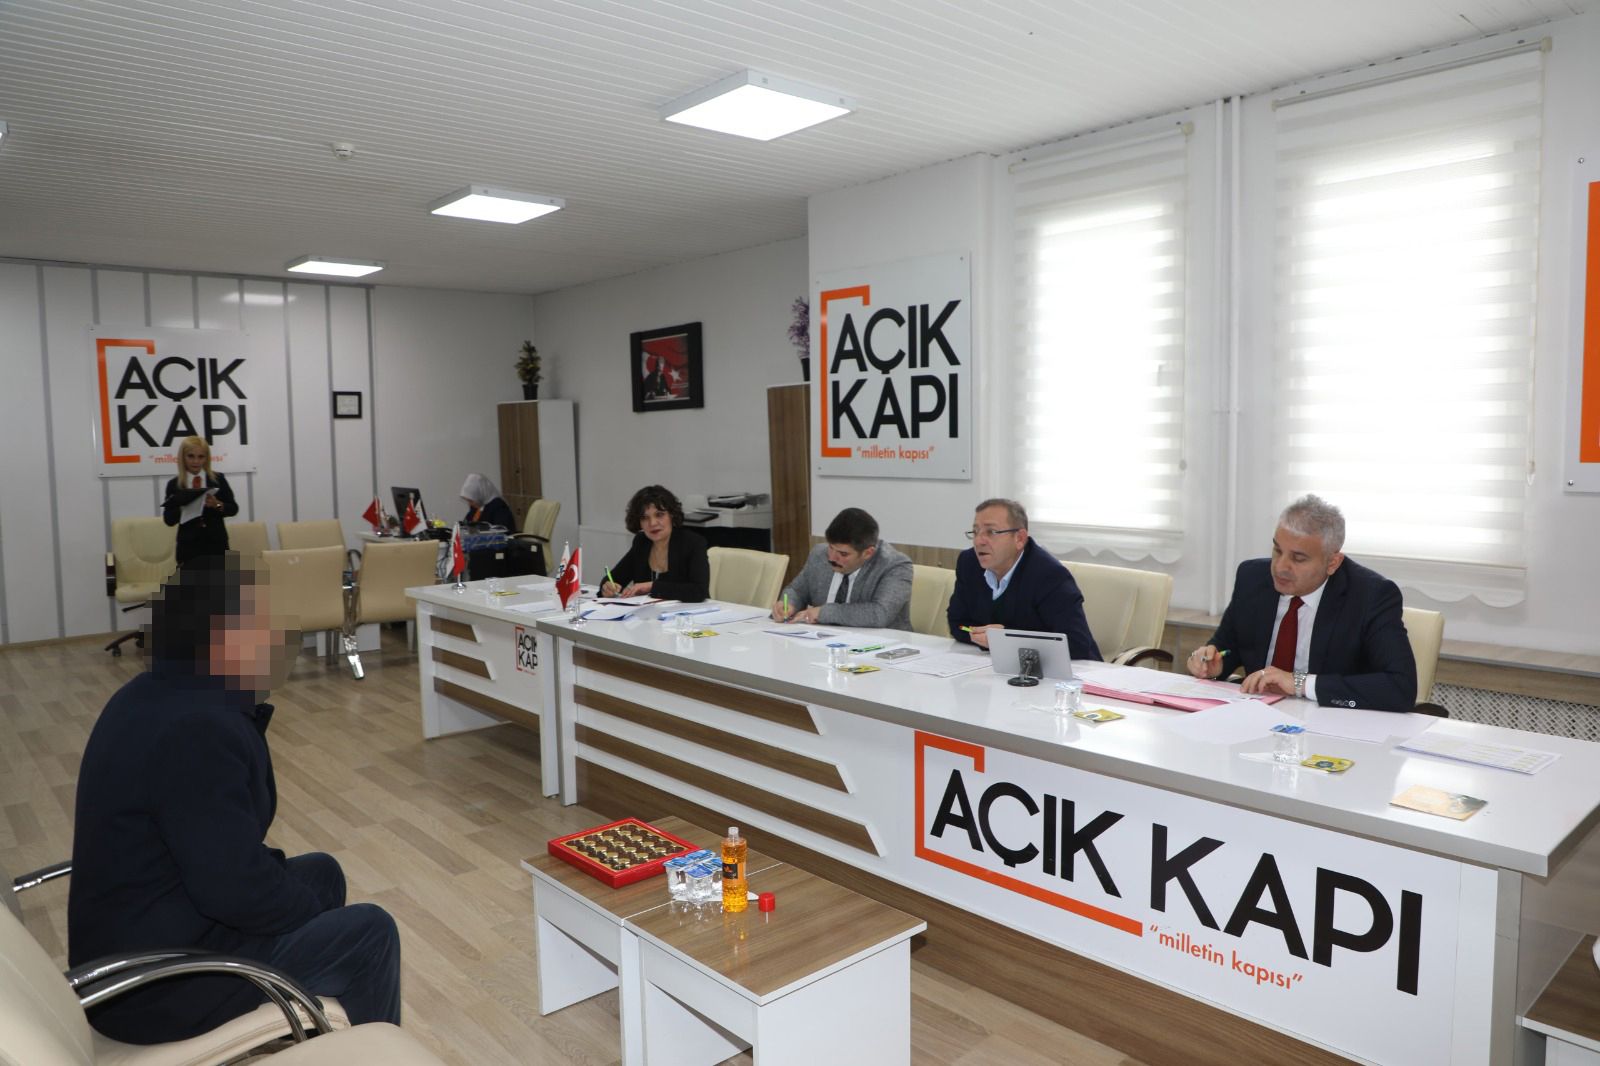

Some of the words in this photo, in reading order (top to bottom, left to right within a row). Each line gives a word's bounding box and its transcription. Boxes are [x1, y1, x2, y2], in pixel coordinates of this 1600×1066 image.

[829, 300, 961, 374] AÇIK
[115, 356, 247, 402] AÇIK
[832, 373, 958, 439] KAPI
[118, 404, 248, 448] KAPI
[930, 769, 1125, 898] AÇIK
[1151, 823, 1423, 996] KAPI
